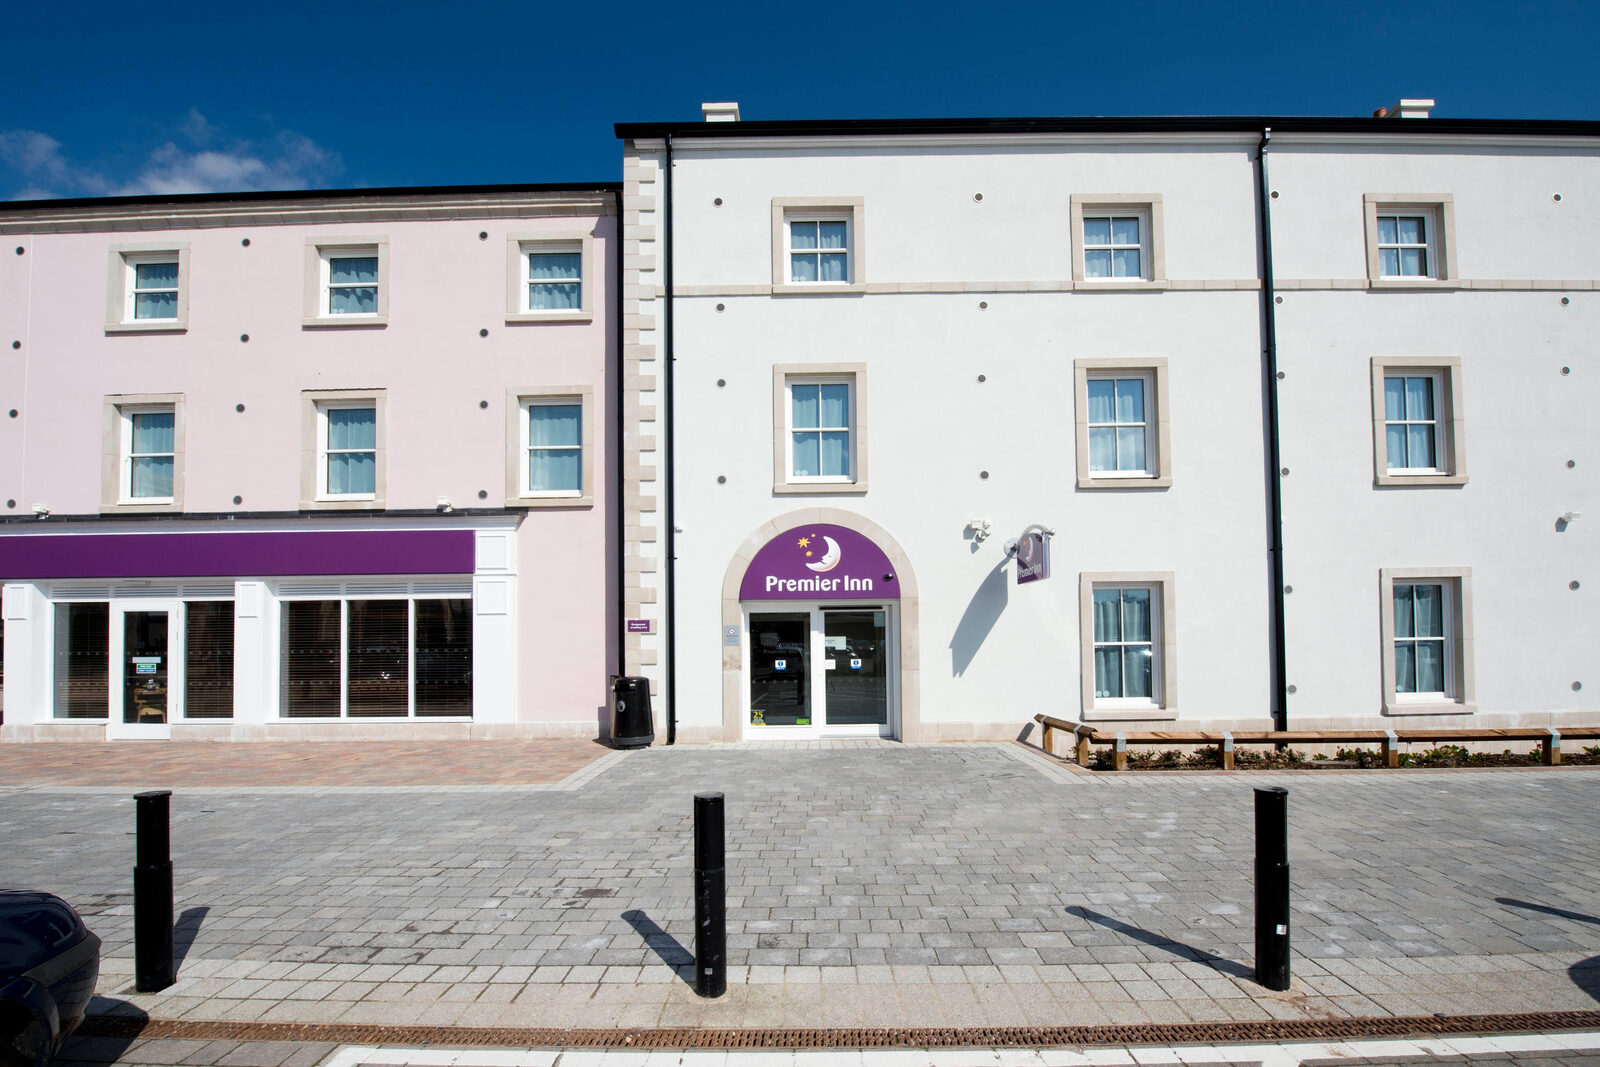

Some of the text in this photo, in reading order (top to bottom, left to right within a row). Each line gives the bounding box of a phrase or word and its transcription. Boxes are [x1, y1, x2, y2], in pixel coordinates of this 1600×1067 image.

[765, 575, 873, 592] Premier Inn
[753, 711, 764, 719] 25
